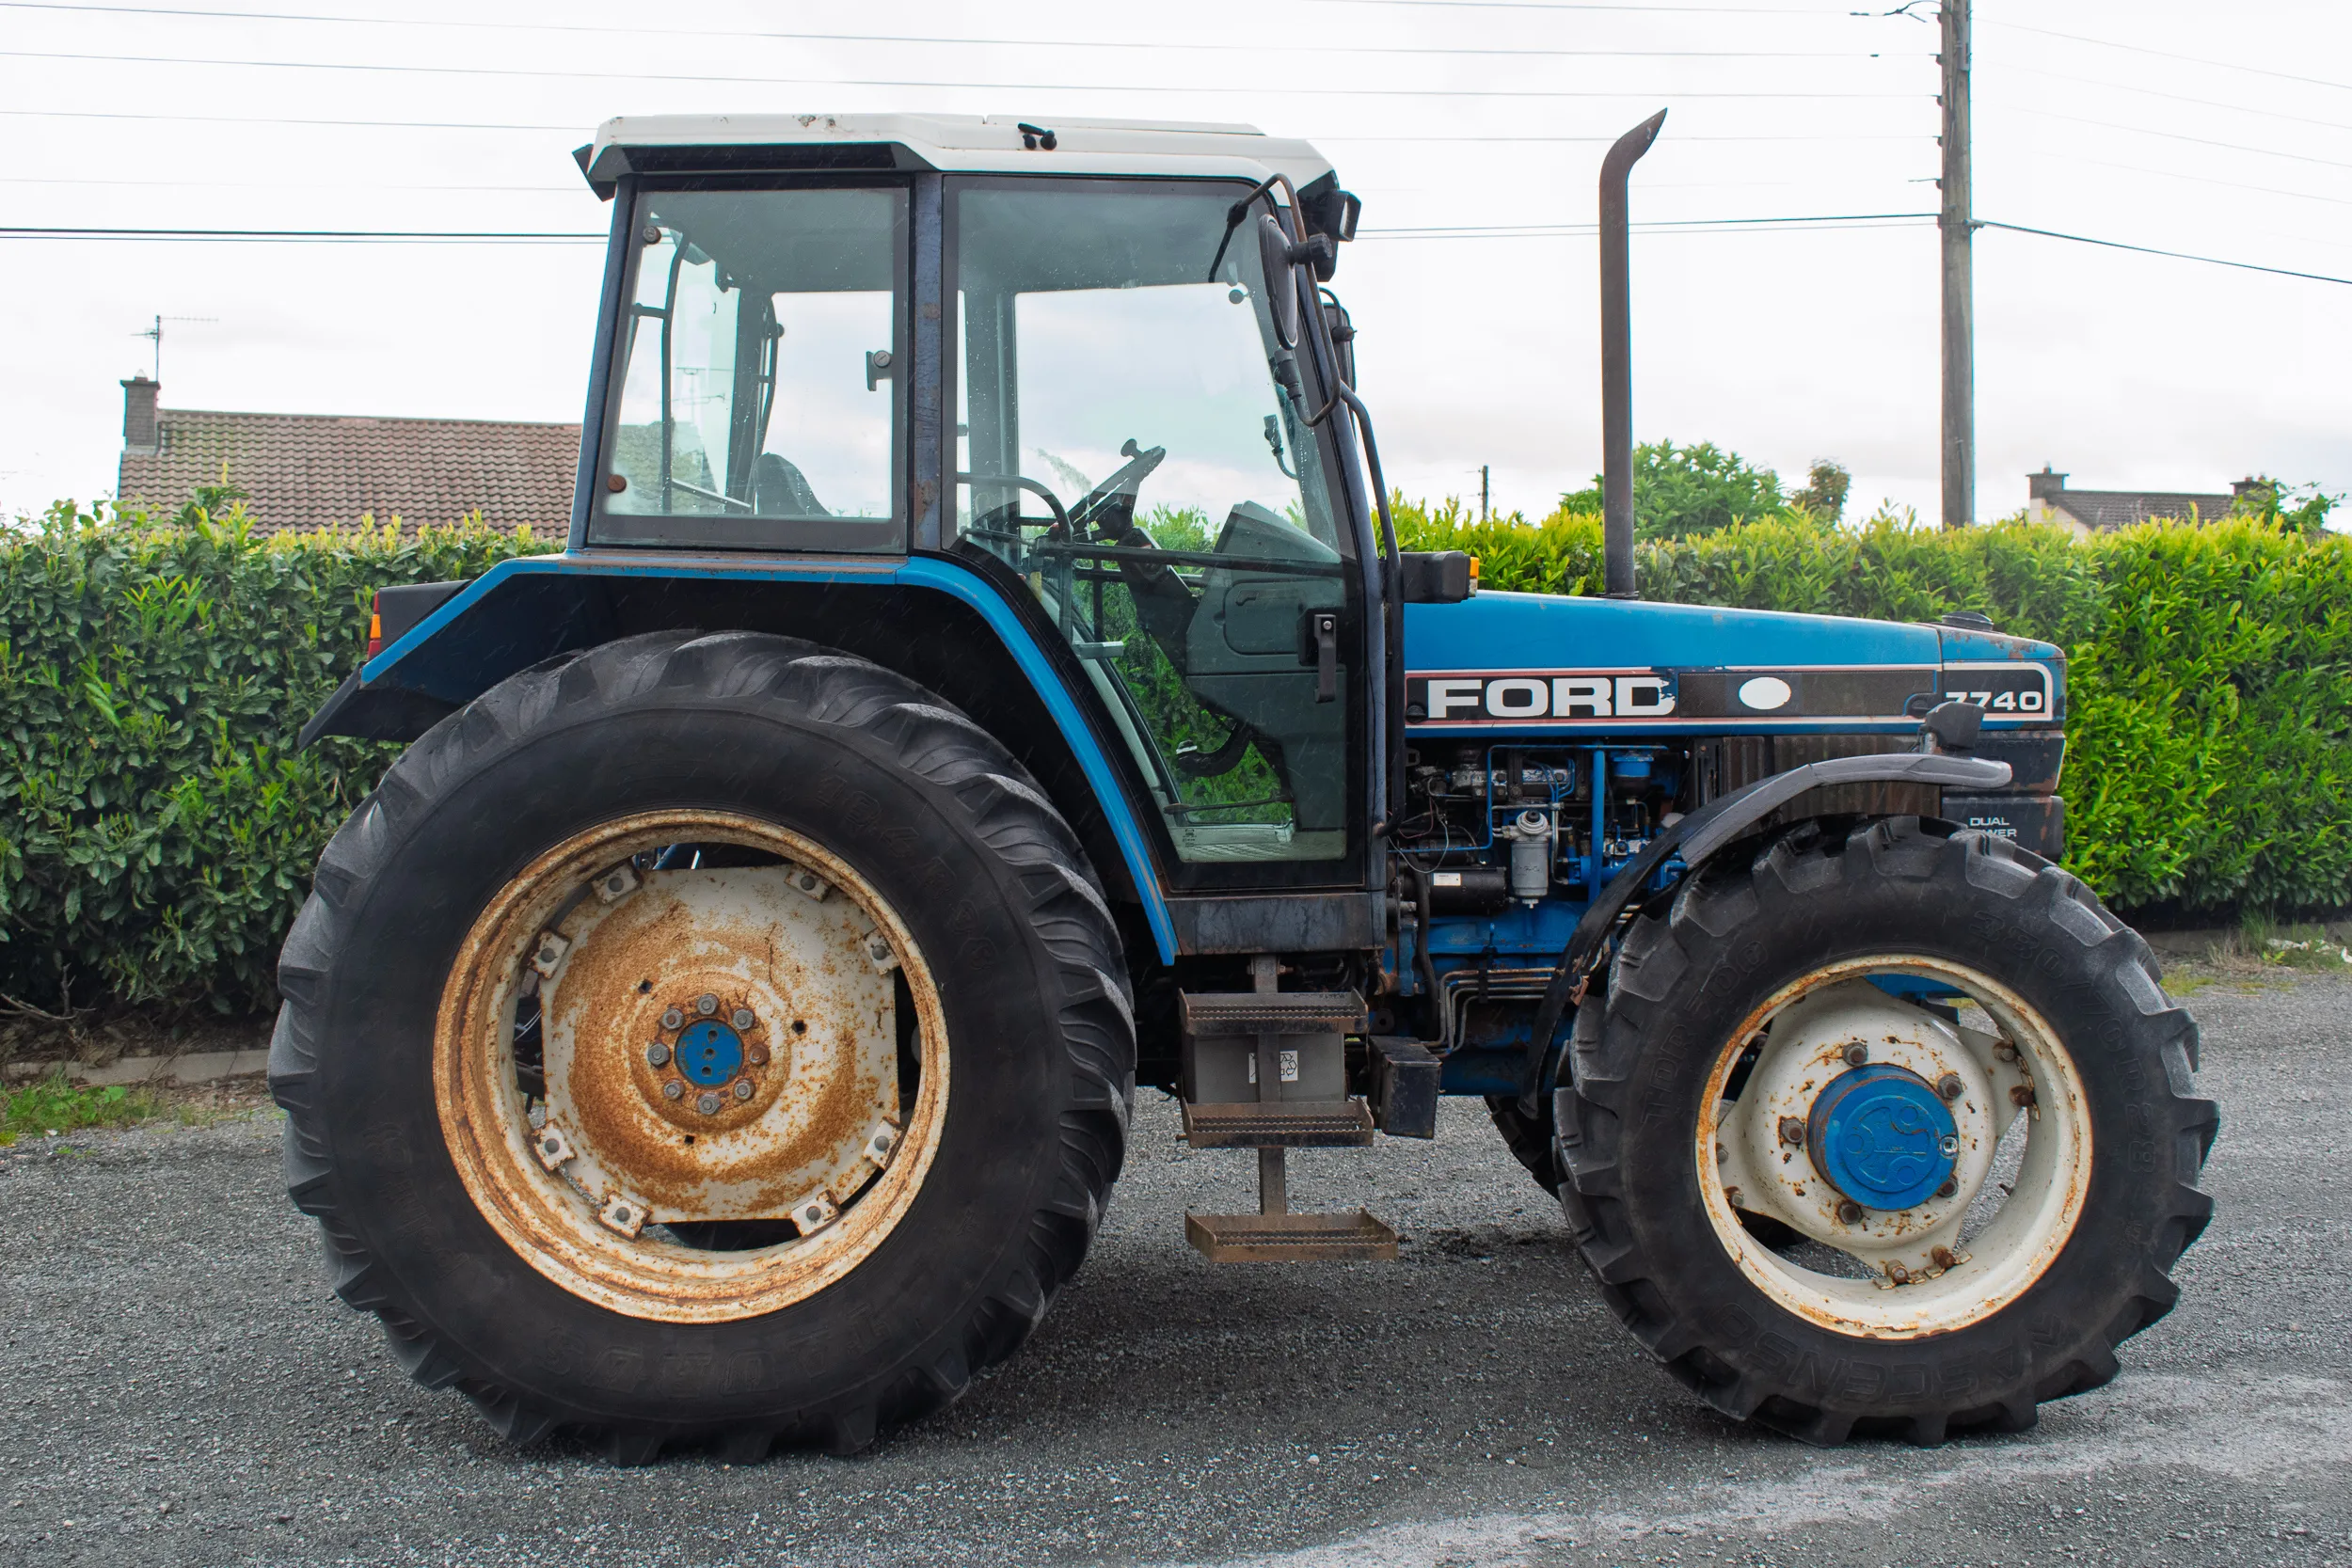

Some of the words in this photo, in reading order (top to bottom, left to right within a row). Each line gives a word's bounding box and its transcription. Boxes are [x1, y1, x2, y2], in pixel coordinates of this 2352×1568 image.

[1427, 677, 1676, 718] FORD
[1946, 691, 2043, 711] 7740
[1969, 817, 2010, 826] DUAL
